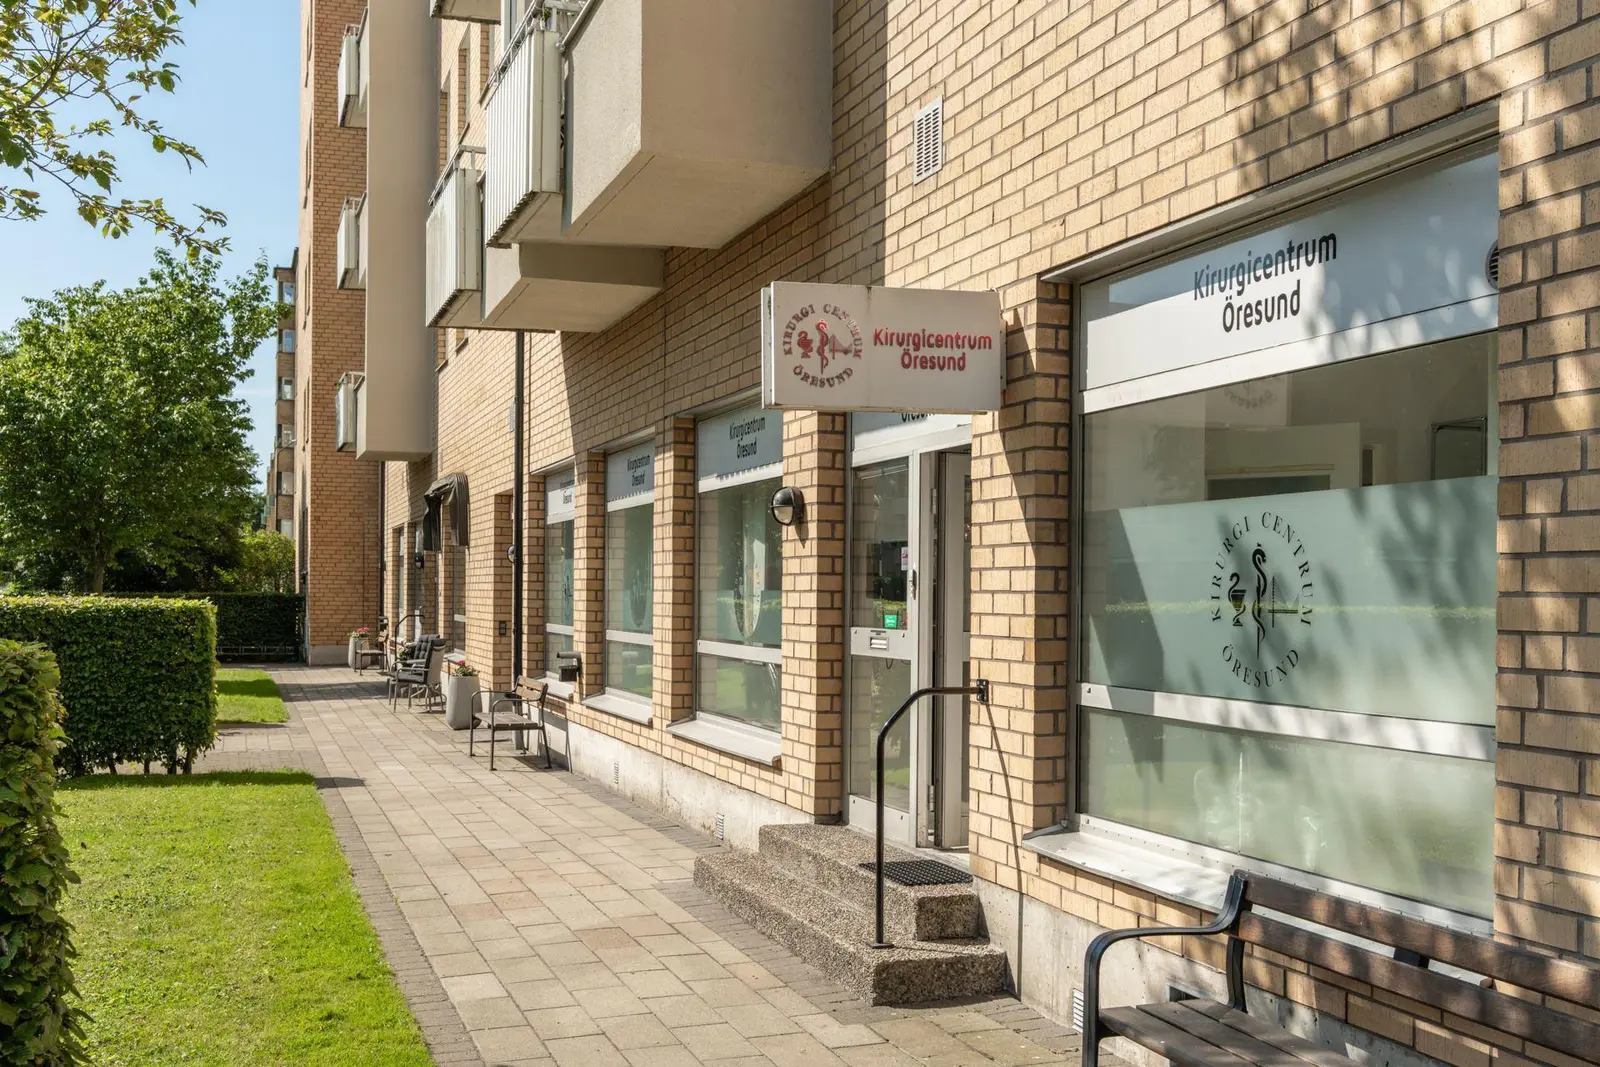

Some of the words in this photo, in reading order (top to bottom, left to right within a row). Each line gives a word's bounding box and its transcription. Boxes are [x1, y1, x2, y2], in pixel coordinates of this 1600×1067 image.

[1194, 232, 1337, 301] Kirurgicentrum
[1222, 279, 1301, 333] Öresund
[782, 303, 816, 356] KIRURGI
[823, 303, 863, 360] CENTRUM
[873, 327, 993, 352] Kirurgicentrum
[793, 364, 854, 388] ÖRESUND
[900, 348, 966, 371] Öresund
[729, 416, 766, 441] Kirurgicentrum
[736, 437, 757, 459] Öresund
[1210, 515, 1252, 623] KIRURGI
[1261, 510, 1314, 626] CENTRUM
[1222, 643, 1299, 688] ÖRESUND
